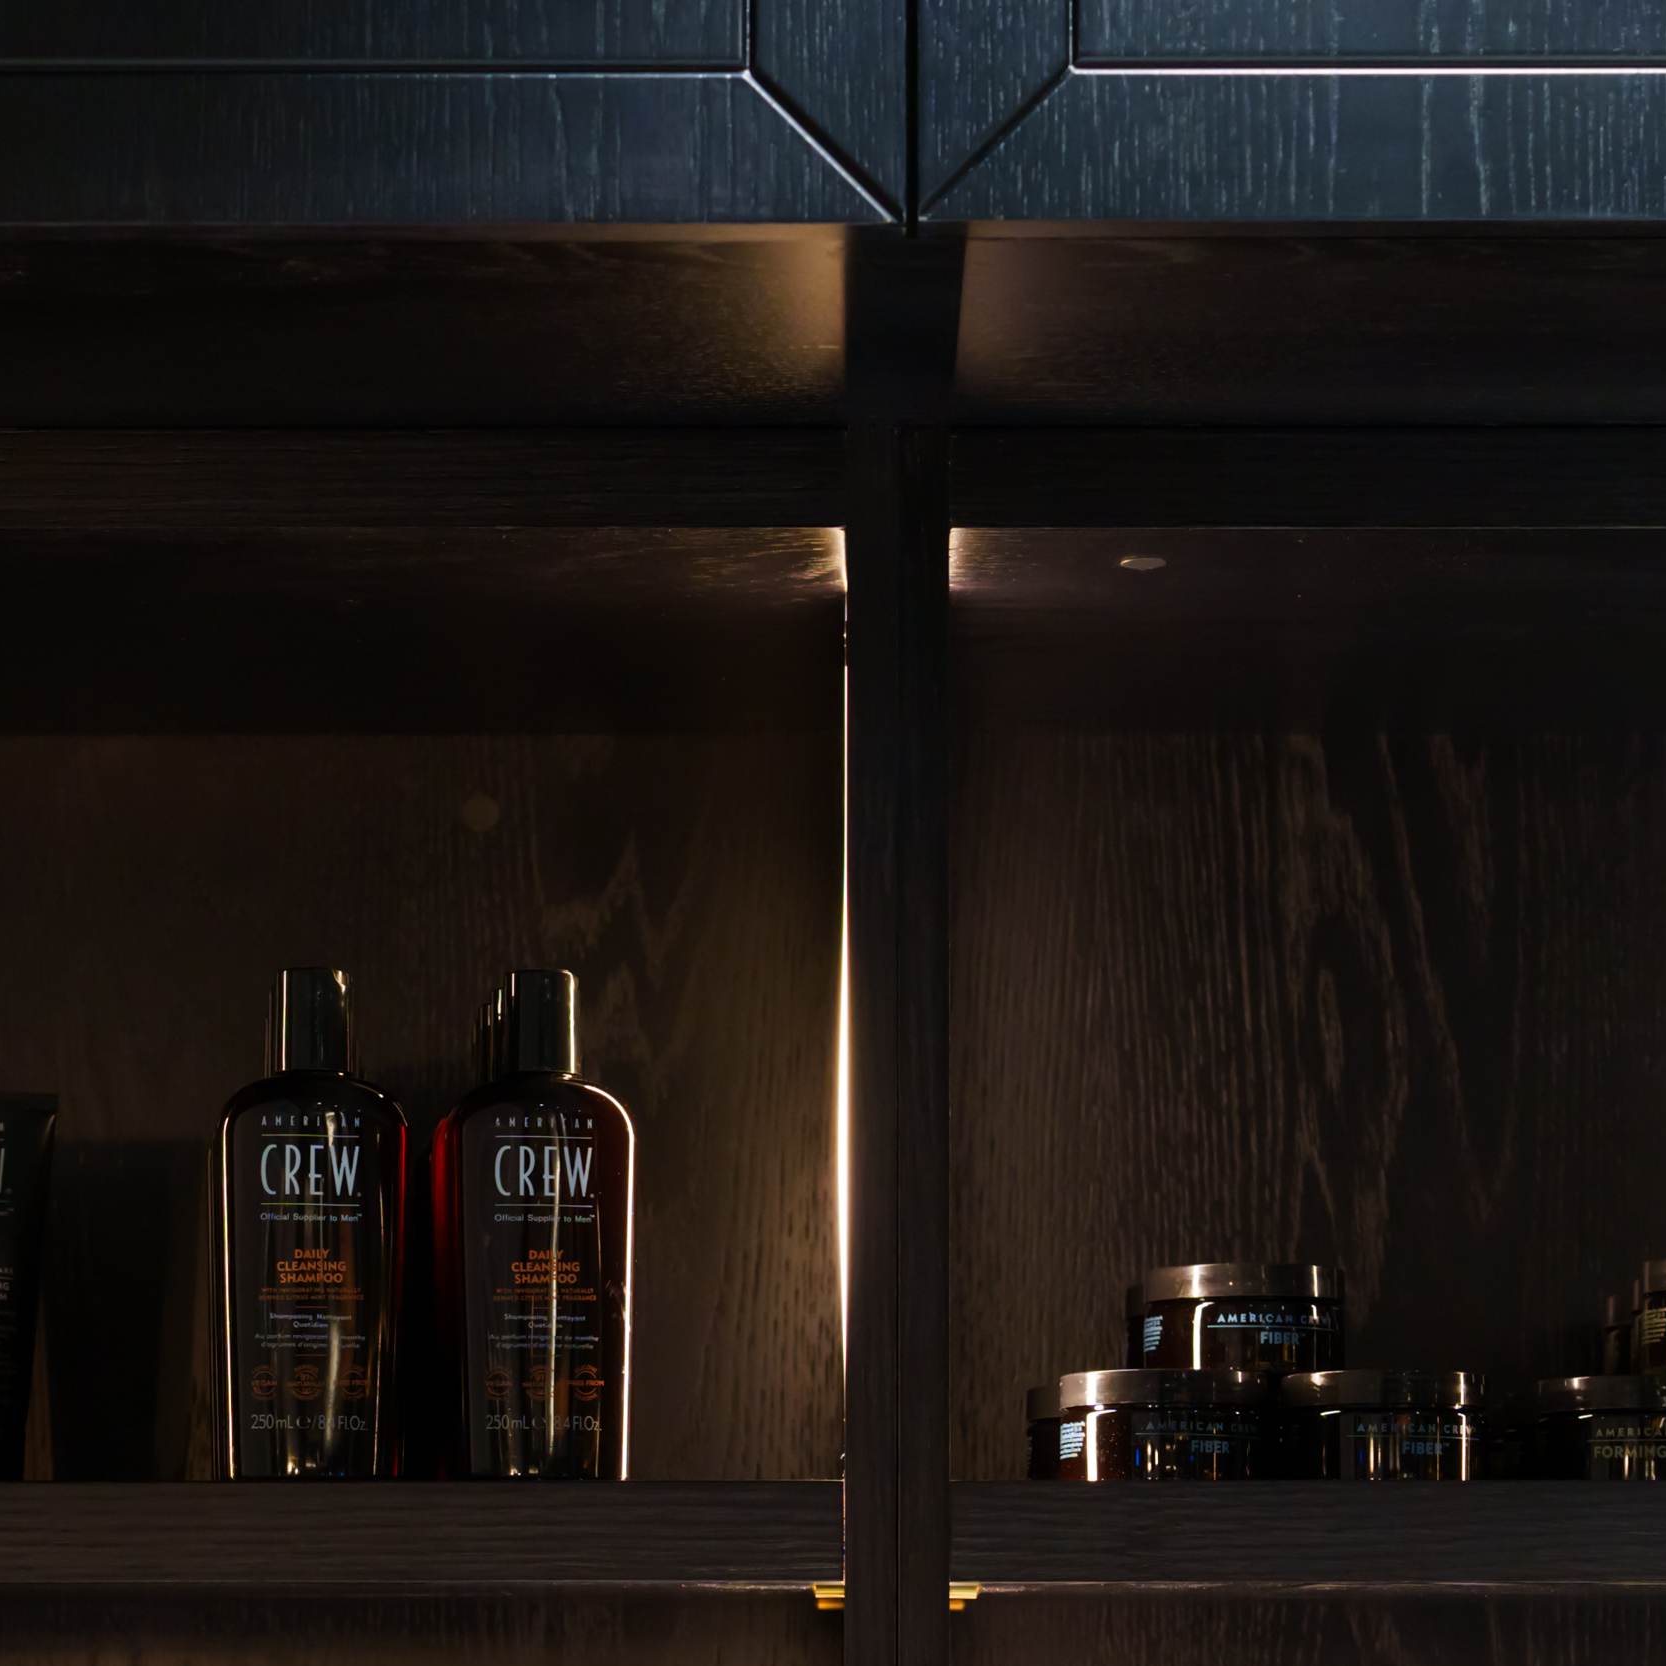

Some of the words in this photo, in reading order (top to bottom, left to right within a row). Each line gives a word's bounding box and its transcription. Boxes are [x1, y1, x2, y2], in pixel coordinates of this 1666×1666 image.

[260, 1144, 360, 1196] CREW
[494, 1145, 593, 1197] CREW
[260, 1212, 290, 1221] Official
[293, 1213, 326, 1223] Supplier
[330, 1214, 337, 1222] to
[295, 1249, 329, 1259] DAILY
[277, 1261, 347, 1272] CLEANSING
[280, 1273, 343, 1283] SHAMPOO
[1217, 1312, 1293, 1324] AMERICAN
